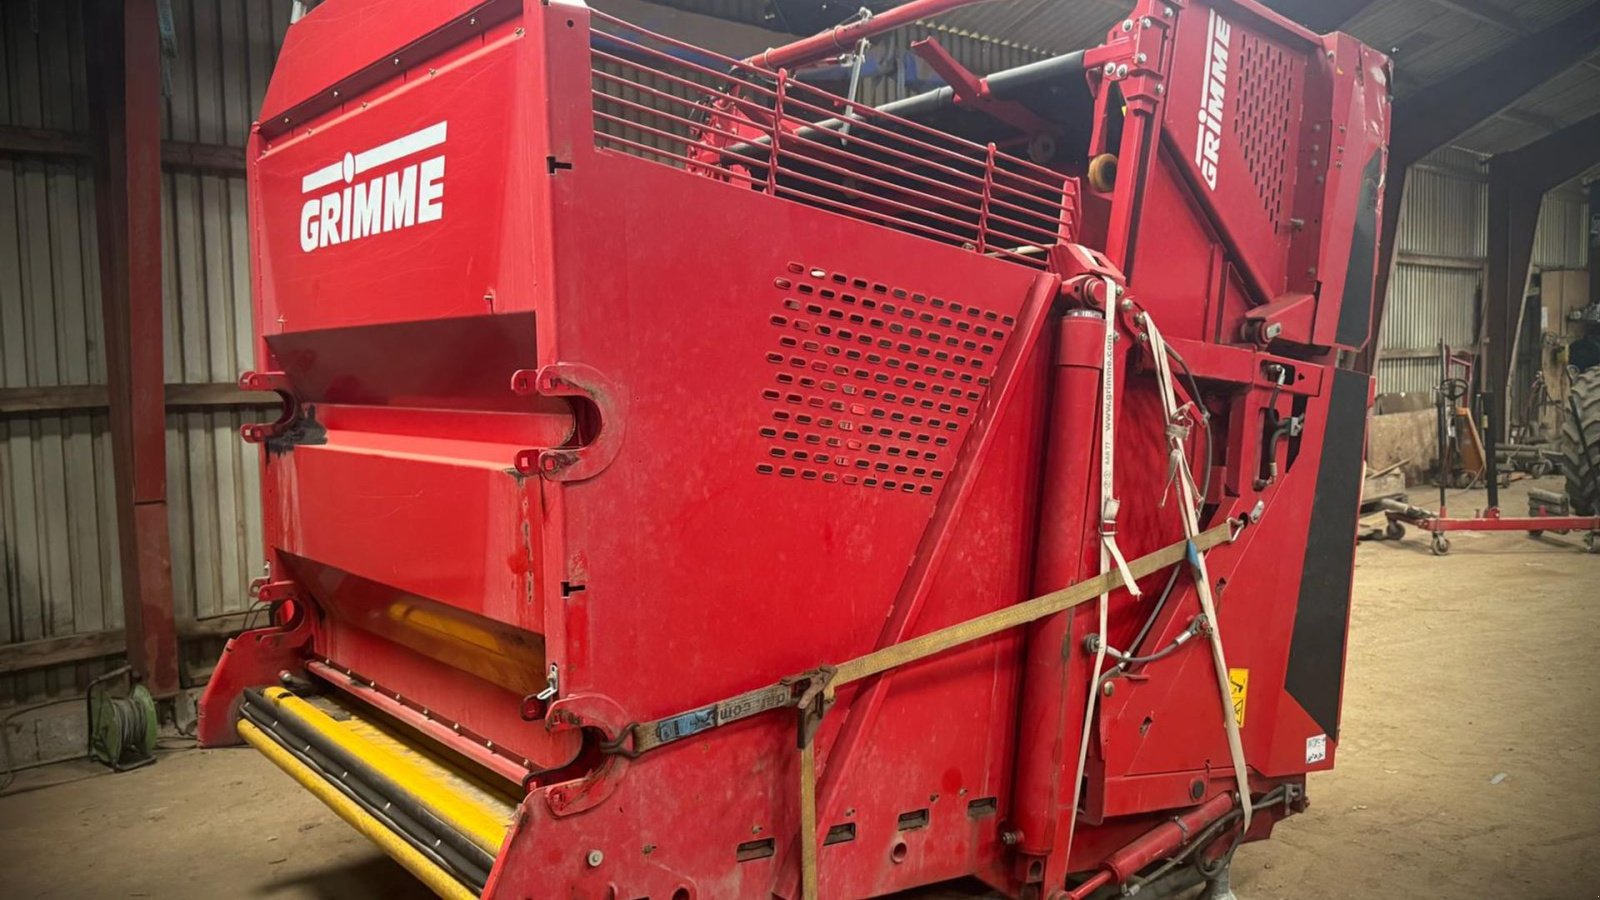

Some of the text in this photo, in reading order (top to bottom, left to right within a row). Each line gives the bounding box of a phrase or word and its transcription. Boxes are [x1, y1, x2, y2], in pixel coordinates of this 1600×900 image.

[1199, 14, 1231, 192] GRIMME
[301, 153, 446, 252] GRIMME
[1105, 334, 1113, 432] www.grimme.com
